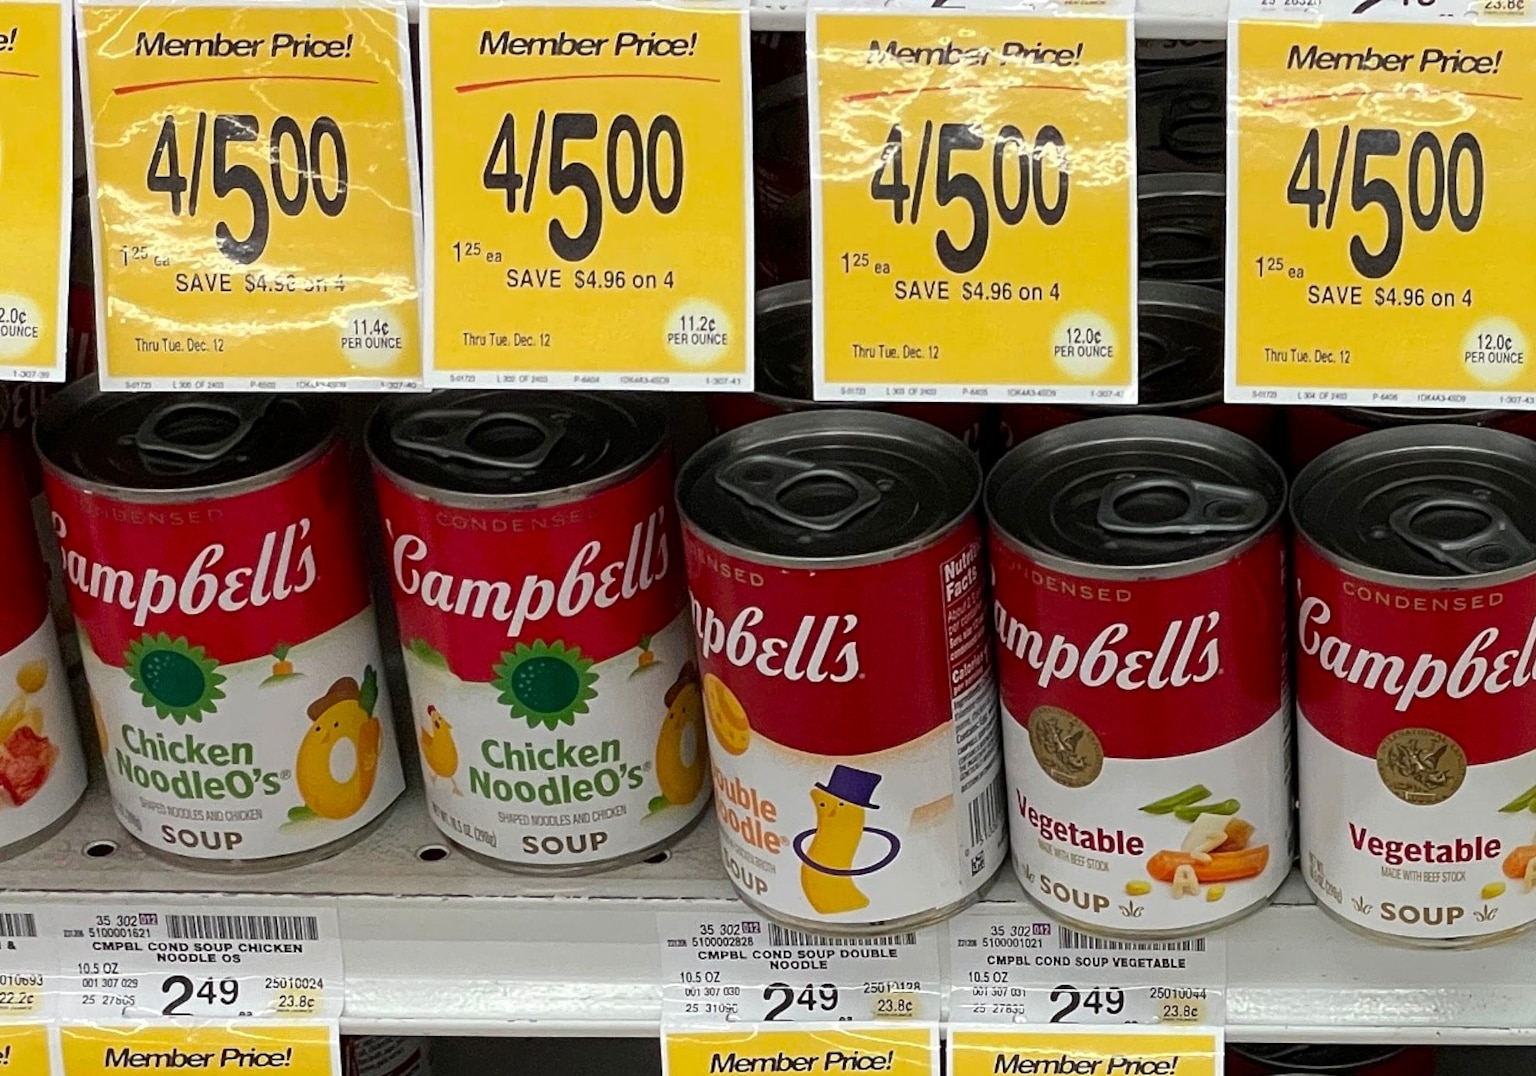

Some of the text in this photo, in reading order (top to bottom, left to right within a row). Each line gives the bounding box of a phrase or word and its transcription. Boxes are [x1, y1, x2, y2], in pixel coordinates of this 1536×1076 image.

[480, 31, 696, 58] Member Price!
[463, 333, 484, 347] Thru
[540, 333, 551, 347] 12
[386, 507, 668, 636] Campbell's
[1342, 581, 1504, 612] CONDENSED
[122, 725, 253, 767] Chicken
[482, 735, 620, 771] Chicken
[162, 823, 243, 850] SOUP
[1016, 789, 1145, 857] Vegetable
[523, 832, 609, 856] SOUP
[1349, 823, 1501, 865] Vegetable
[1381, 867, 1467, 884] MADE WITH BEEF STOCK
[1040, 874, 1111, 916] SOUP
[1381, 902, 1464, 926] SOUP
[93, 943, 302, 953] CMPBL COND SOUP CHICKEN
[157, 953, 241, 963] NOODLE OS
[105, 1048, 291, 1067] Member Price!
